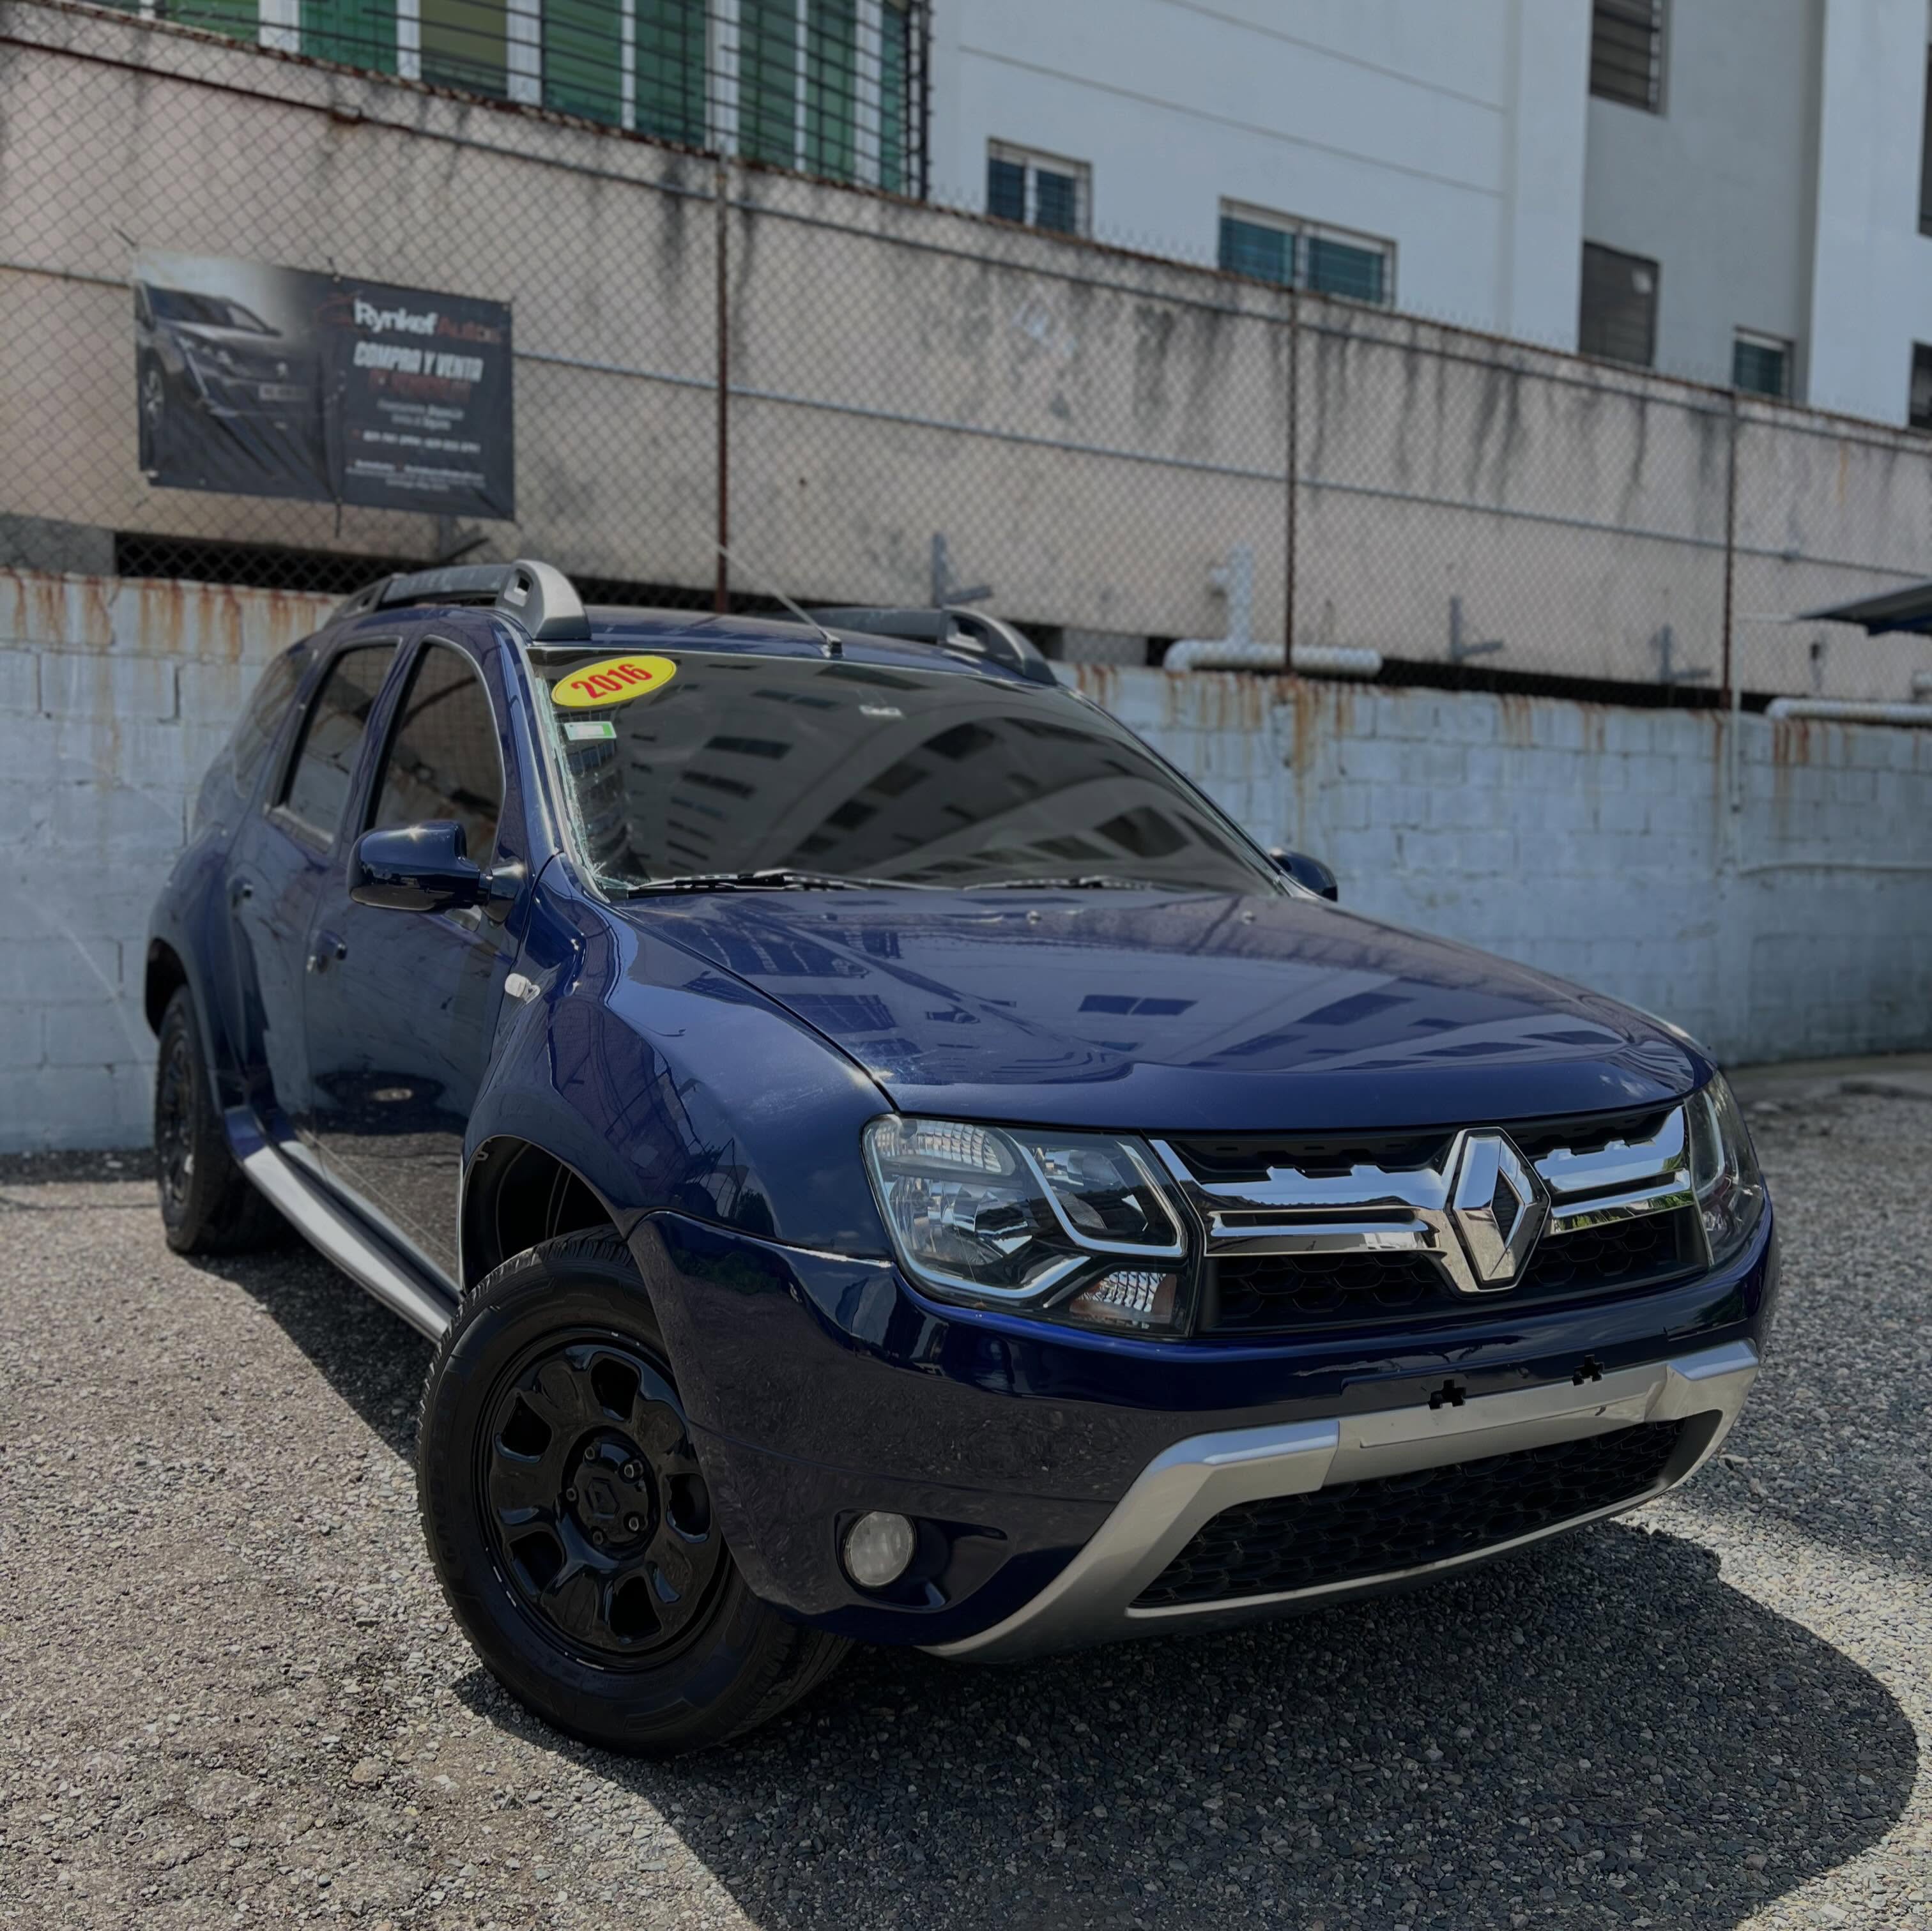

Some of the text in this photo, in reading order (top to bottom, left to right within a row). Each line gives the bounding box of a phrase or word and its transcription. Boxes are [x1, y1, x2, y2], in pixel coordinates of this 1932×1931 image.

[353, 341, 483, 381] COMPRA Y VENTA
[571, 664, 652, 699] 2016
